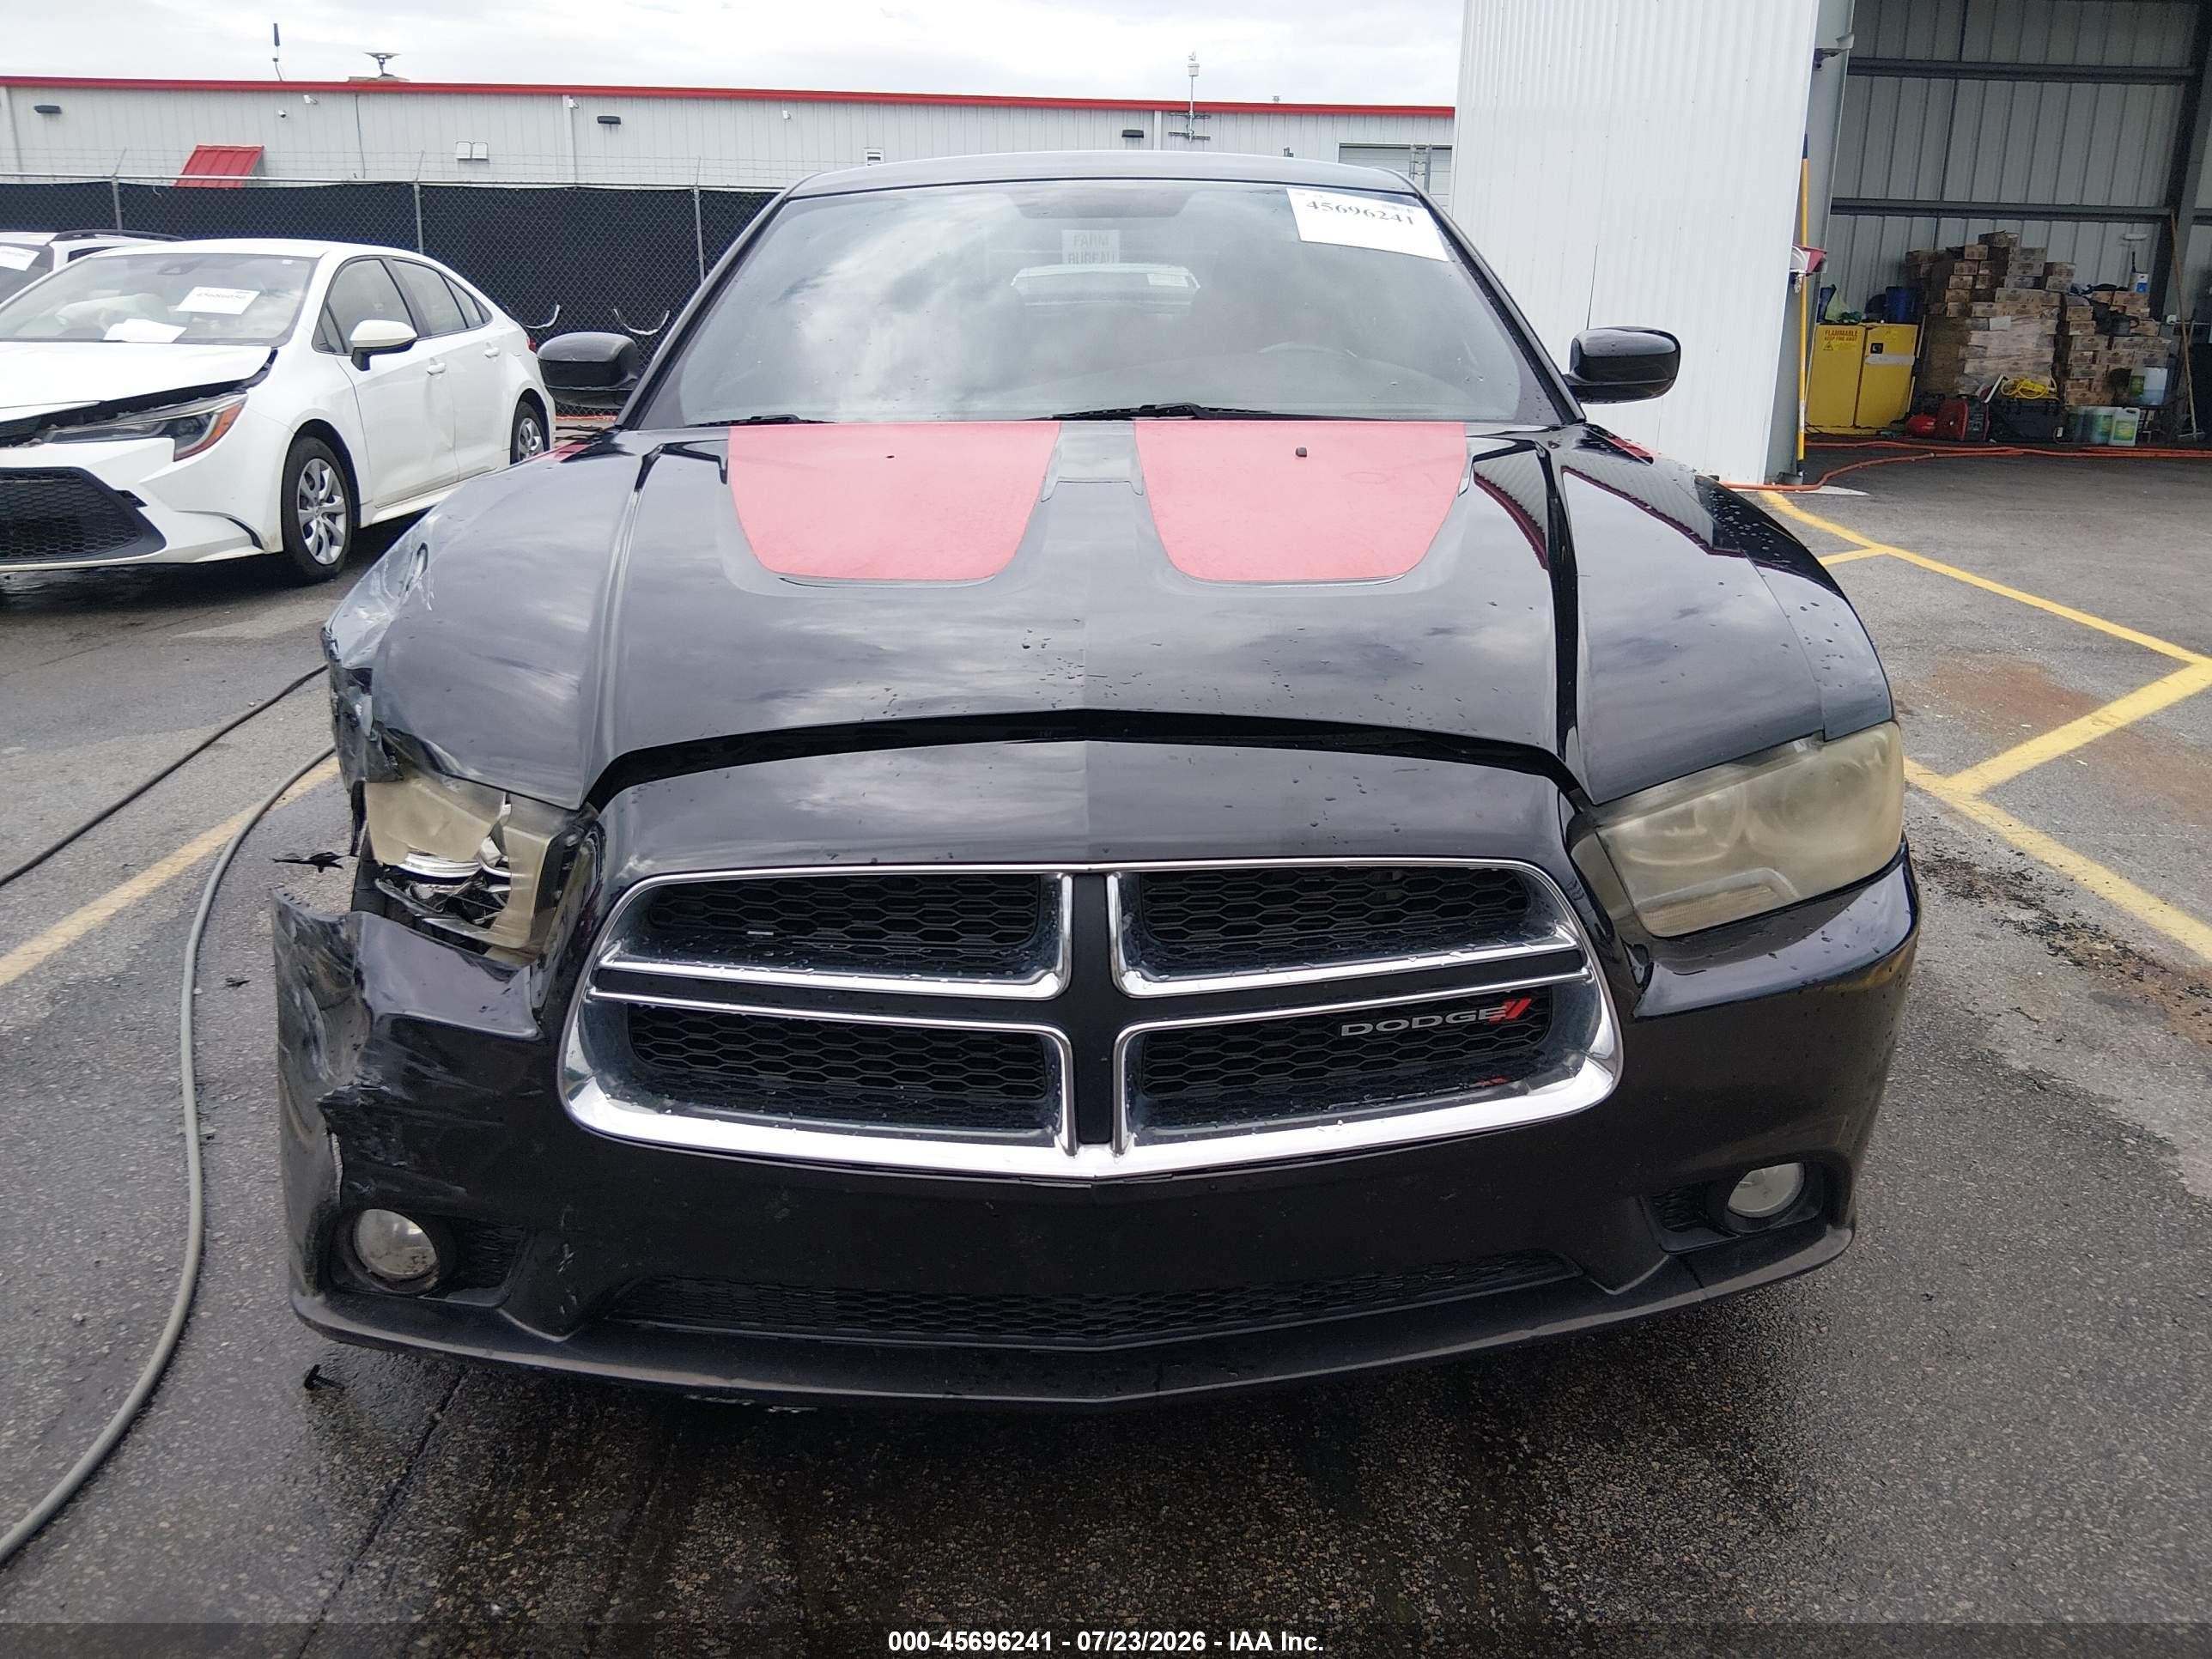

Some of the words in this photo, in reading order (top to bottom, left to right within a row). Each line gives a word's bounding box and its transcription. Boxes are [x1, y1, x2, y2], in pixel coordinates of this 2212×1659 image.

[1306, 200, 1413, 225] 45696241
[1073, 234, 1109, 248] FARM
[1340, 1005, 1507, 1037] DODGE
